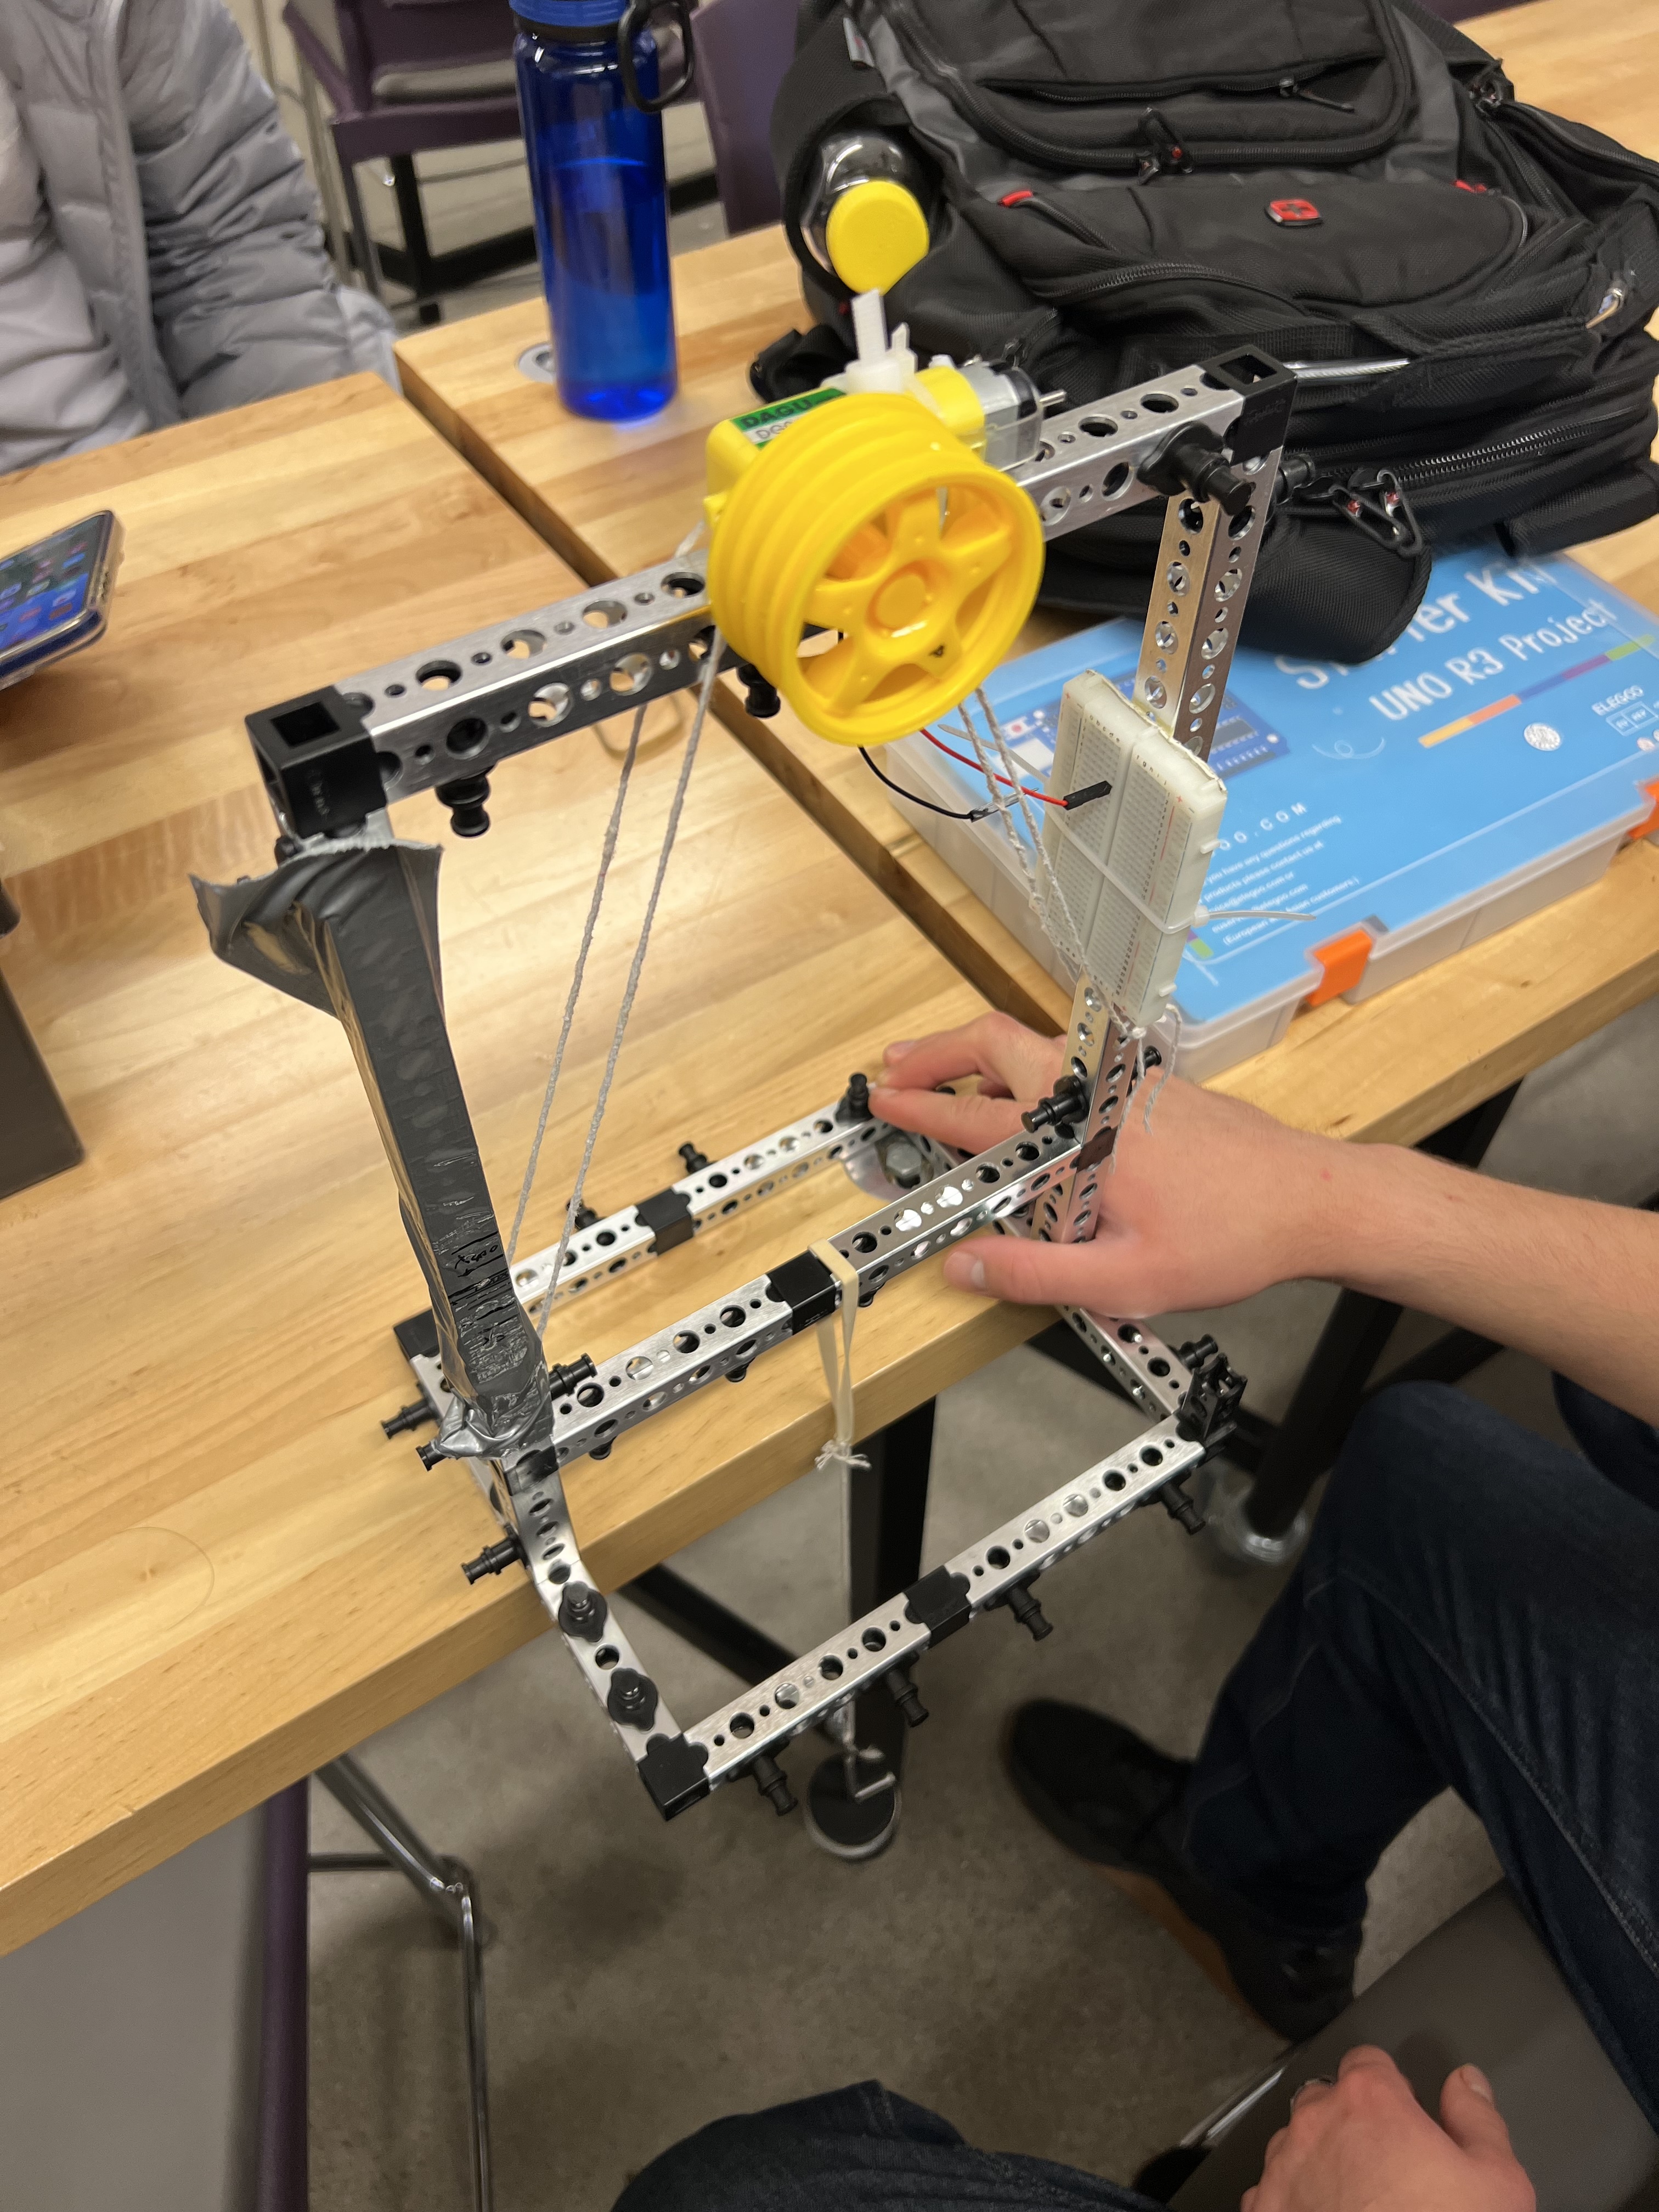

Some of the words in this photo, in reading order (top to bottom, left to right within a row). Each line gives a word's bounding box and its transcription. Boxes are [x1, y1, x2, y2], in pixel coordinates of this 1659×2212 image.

[741, 399, 813, 428] DAGU
[1368, 672, 1453, 722] UNO
[1443, 646, 1505, 687] R3
[1497, 597, 1618, 662] Project
[1592, 685, 1644, 716] ELEGOO
